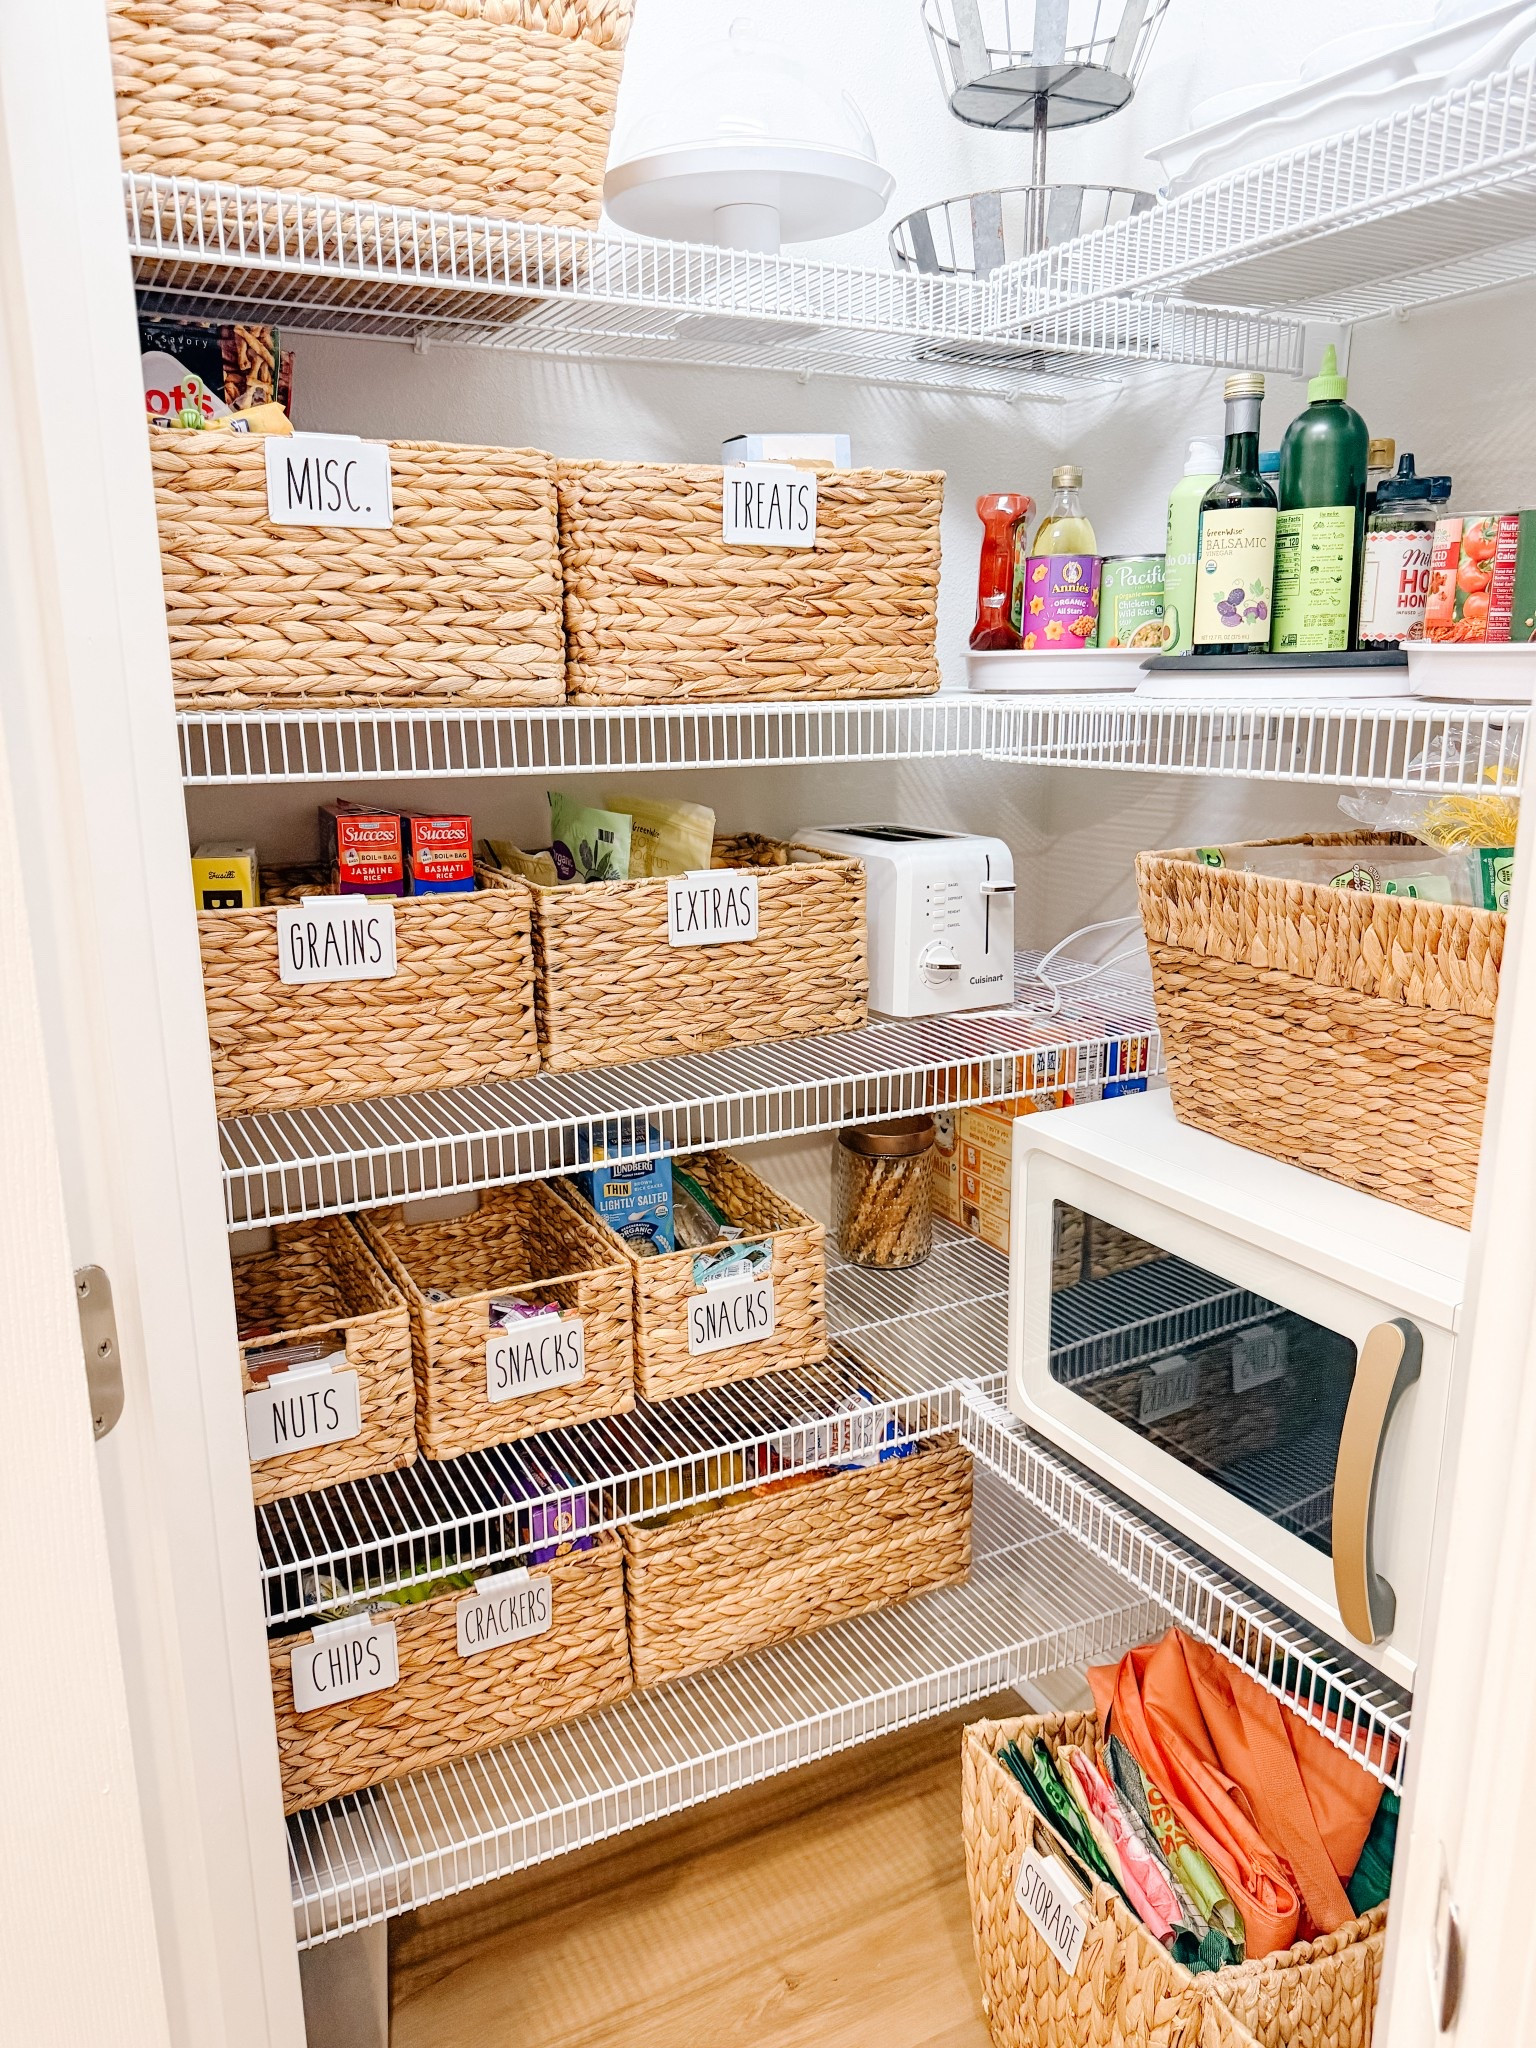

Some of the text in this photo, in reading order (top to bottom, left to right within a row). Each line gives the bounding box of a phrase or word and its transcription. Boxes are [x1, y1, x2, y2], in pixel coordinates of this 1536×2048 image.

[161, 334, 208, 349] savory
[286, 457, 372, 512] MISC.
[731, 481, 809, 531] TREATS
[1206, 528, 1244, 538] GreenWise
[1206, 538, 1267, 551] BALSAMIC
[1289, 537, 1300, 547] 120
[1177, 553, 1196, 565] Oil
[1206, 549, 1233, 557] VINEGAR
[1052, 583, 1090, 594] Annie's
[1119, 591, 1141, 600] Organic
[1054, 599, 1087, 607] ORGANIC
[1118, 599, 1156, 609] Chicken &
[1056, 607, 1083, 615] All Stars
[1118, 608, 1154, 618] Wild Rice
[344, 827, 395, 842] Success
[418, 825, 465, 840] Success
[208, 870, 236, 880] Fusilli
[350, 866, 393, 875] JASMINE
[424, 865, 464, 873] BASMATI
[675, 886, 751, 932] EXTRAS
[290, 918, 382, 970] GRAINS
[969, 974, 1004, 985] Cuisinart
[613, 1160, 653, 1178] LUNDBERG
[606, 1184, 629, 1195] THIN
[600, 1192, 668, 1212] LIGHTLY SALTED
[619, 1227, 653, 1238] ORGANIC
[693, 1290, 768, 1343] SNACKS
[495, 1330, 579, 1388] SNACKS
[272, 1388, 339, 1444] NUTS
[465, 1587, 547, 1645] CRACKERS
[312, 1636, 381, 1692] CHIPS
[1021, 1864, 1080, 1962] STORAGE
